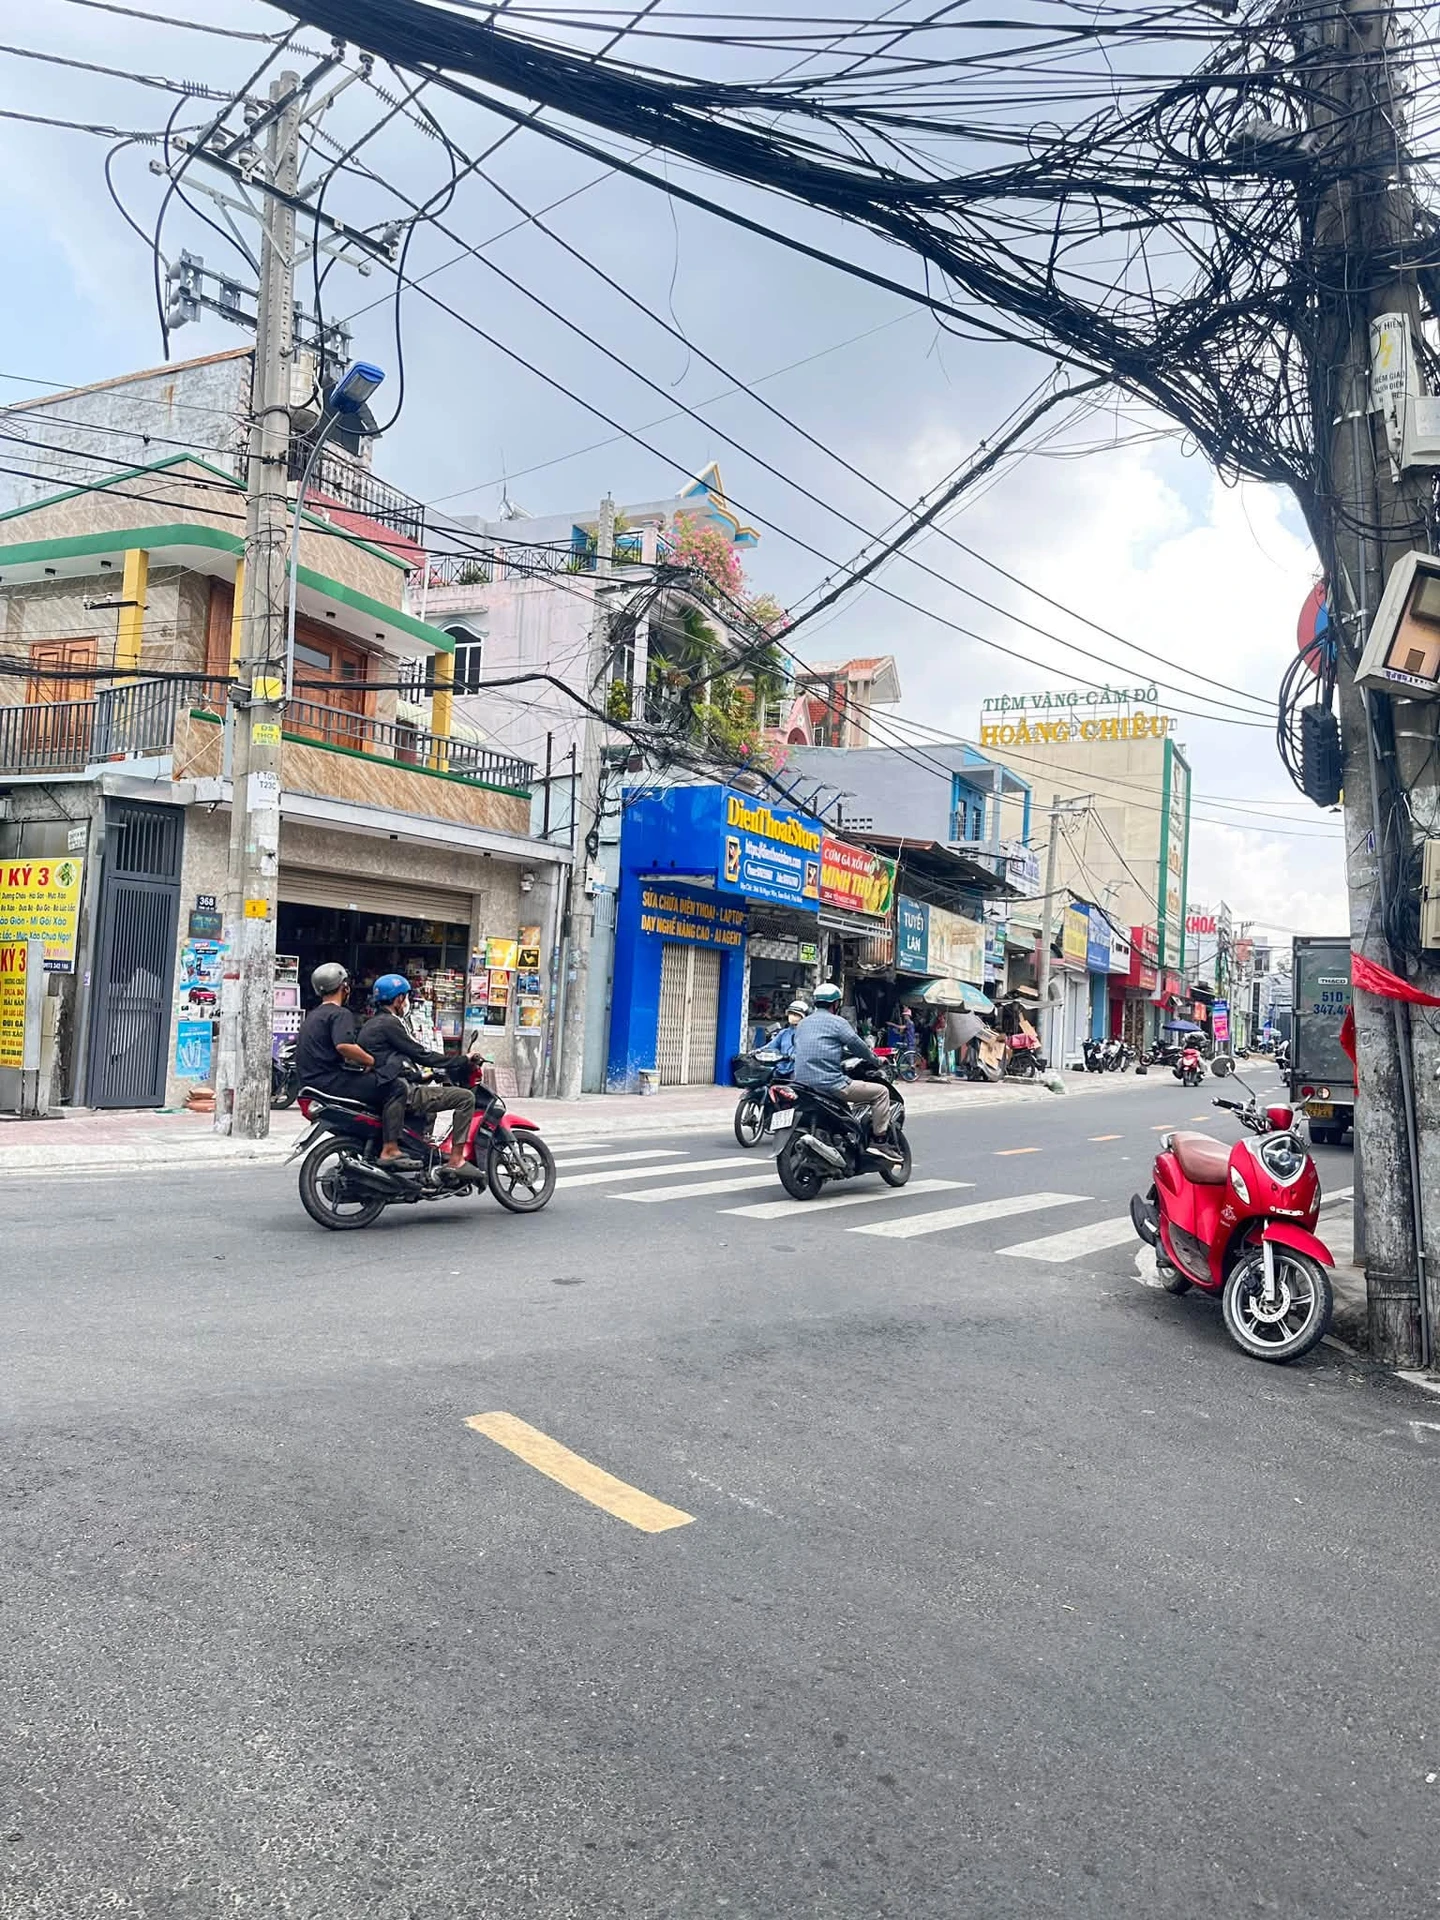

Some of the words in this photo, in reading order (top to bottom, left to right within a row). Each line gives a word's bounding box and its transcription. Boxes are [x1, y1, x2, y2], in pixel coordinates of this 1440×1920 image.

[983, 694, 1026, 714] TIỆM
[726, 796, 820, 853] DienThoaiStore
[824, 848, 841, 863] CƠM
[841, 852, 851, 868] GÀ
[8, 863, 32, 886] KÝ
[37, 867, 50, 886] 3
[822, 864, 852, 895] MINH
[200, 896, 214, 906] 368
[720, 907, 745, 924] LAPTOP
[696, 925, 710, 941] CAO
[722, 929, 742, 946] AGENT
[907, 934, 921, 953] LAN
[1, 943, 16, 972] KÝ
[18, 948, 26, 972] 3
[1322, 992, 1344, 1002] 51D
